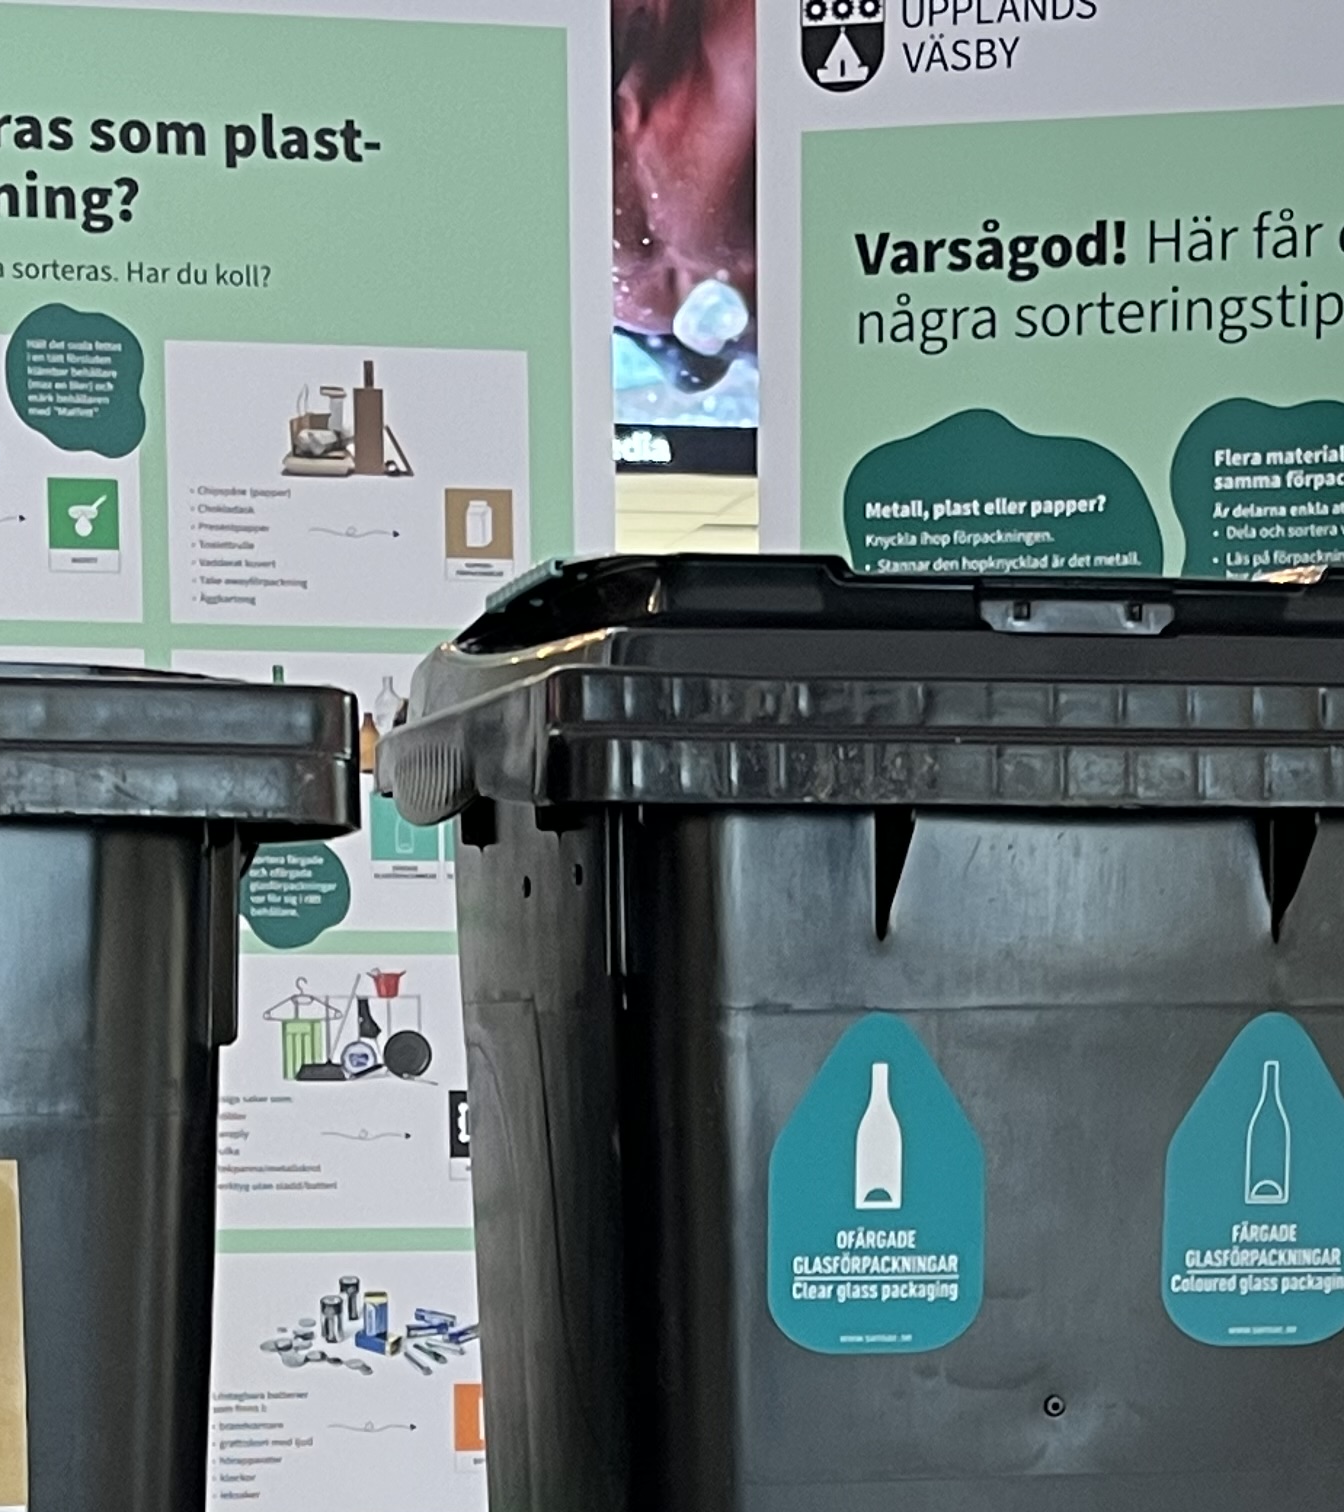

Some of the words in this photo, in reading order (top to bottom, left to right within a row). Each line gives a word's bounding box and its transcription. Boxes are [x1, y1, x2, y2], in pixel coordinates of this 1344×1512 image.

[902, 0, 1097, 28] UPPLANDS
[902, 33, 1020, 73] VÄSBY
[90, 118, 206, 156] som
[225, 113, 381, 167] plast-
[855, 219, 1127, 282] Varsågod!
[1149, 215, 1239, 264] Här
[1253, 208, 1324, 259] får
[12, 258, 119, 283] sorteras.
[127, 261, 170, 285] Har
[177, 262, 208, 286] du
[216, 263, 272, 288] koll?
[858, 293, 998, 355] några
[1214, 448, 1262, 467] Flera
[1266, 444, 1344, 465] material
[1214, 473, 1281, 490] samma
[865, 500, 929, 521] Metall,
[933, 499, 980, 520] plast
[984, 498, 1026, 516] eller
[1030, 494, 1106, 518] papper?
[1213, 502, 1230, 519] Är
[1232, 502, 1286, 518] delarna
[1290, 501, 1329, 517] enkla
[866, 533, 917, 549] Knyckla
[920, 531, 950, 548] ihop
[953, 529, 1054, 547] förpackningen.
[1226, 524, 1256, 540] Dela
[1259, 523, 1285, 538] och
[1288, 523, 1338, 538] sortera
[877, 557, 930, 573] Stannar
[933, 556, 959, 571] den
[962, 555, 1048, 573] hopknycklad
[1051, 554, 1065, 568] är
[1068, 553, 1091, 568] det
[1094, 552, 1141, 567] metall.
[1226, 551, 1250, 566] Läs
[1252, 551, 1271, 567] på
[837, 1227, 916, 1250] OFÄRGADE
[1232, 1221, 1297, 1243] FÄRGADE
[793, 1251, 957, 1275] GLASFÖRPACKNINGAR
[1186, 1245, 1341, 1268] GLASFÖRPACKNINGAR
[792, 1281, 832, 1300] Clear
[837, 1282, 877, 1302] glass
[882, 1280, 958, 1301] packaging
[1171, 1274, 1235, 1293] Coloured
[1239, 1275, 1278, 1295] glass
